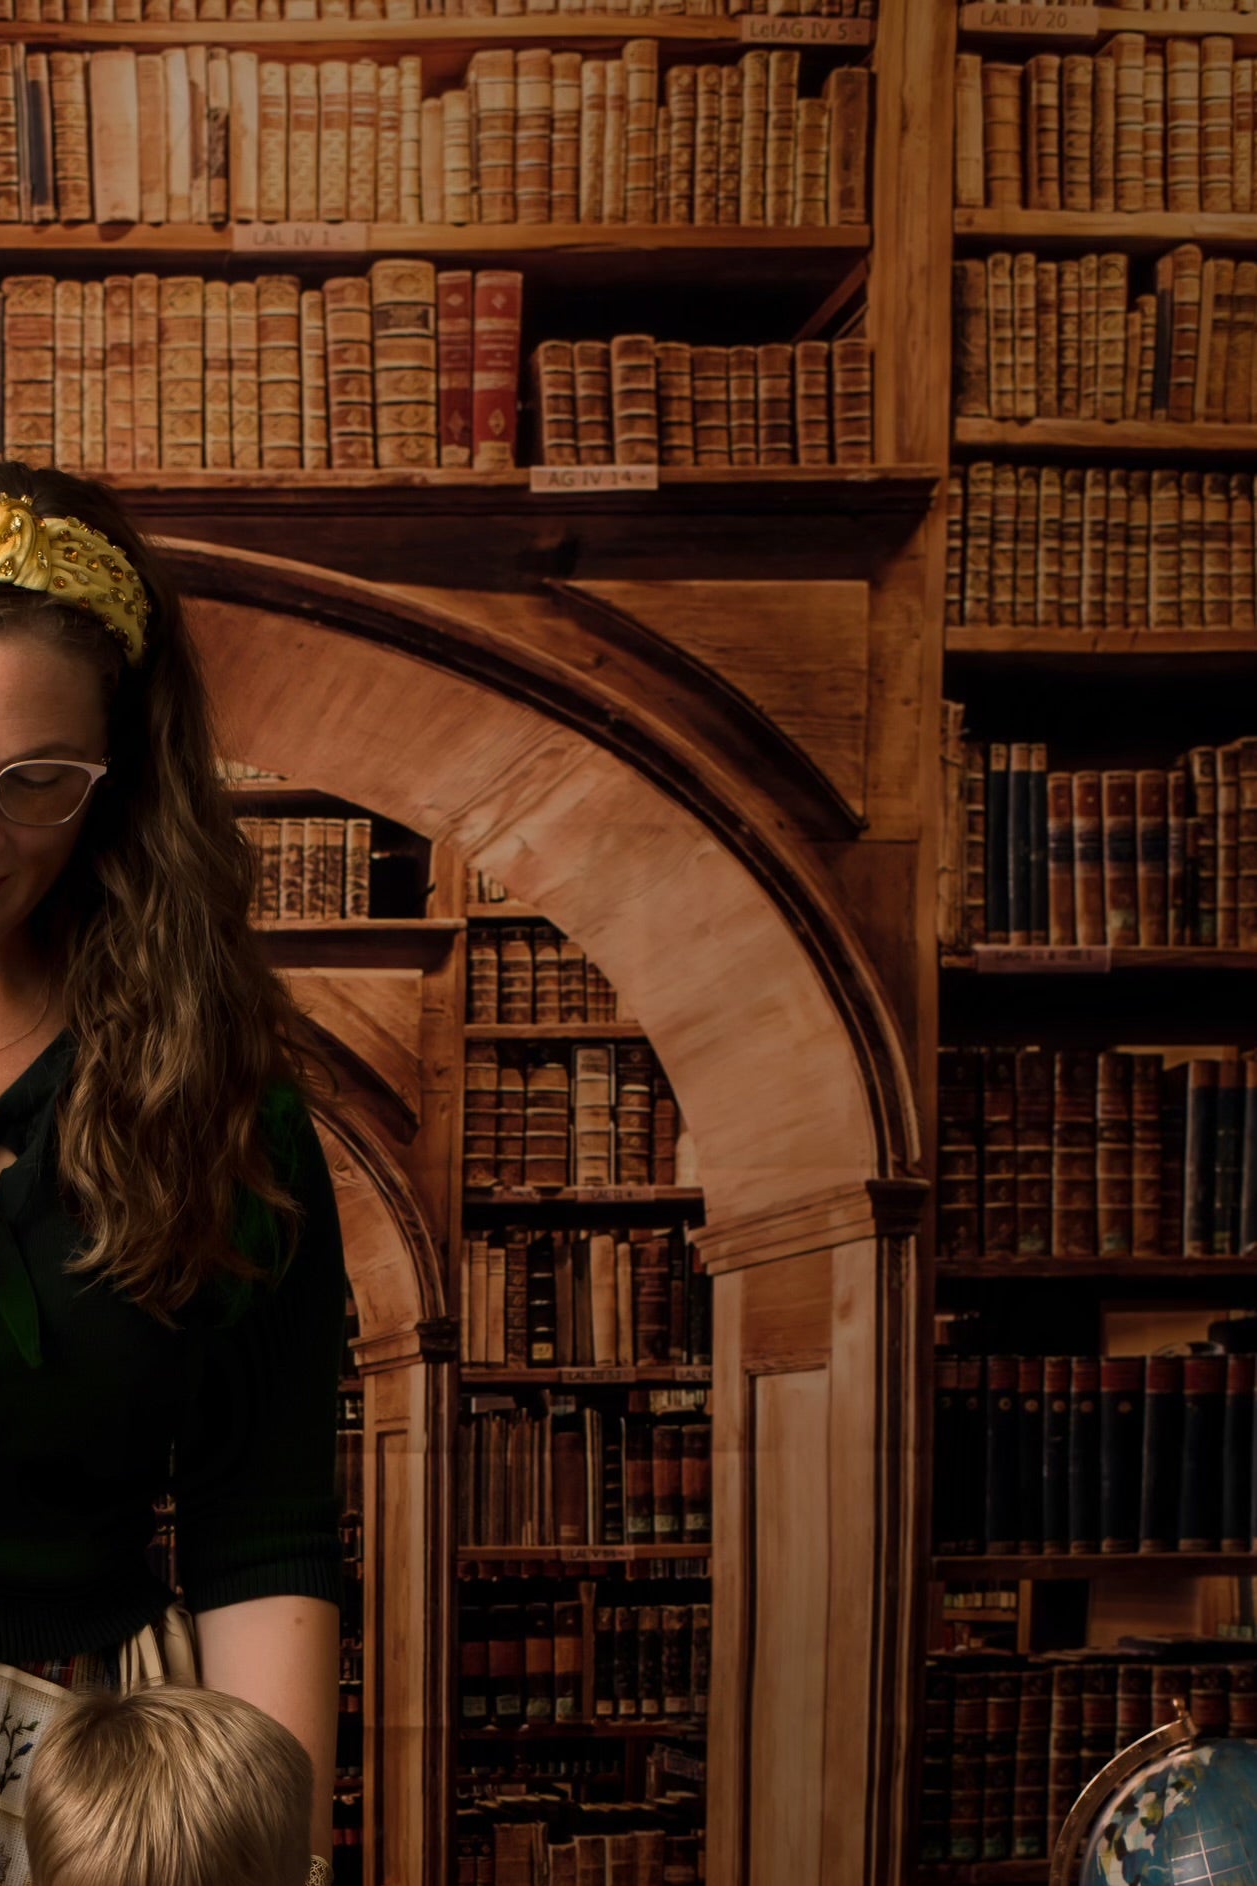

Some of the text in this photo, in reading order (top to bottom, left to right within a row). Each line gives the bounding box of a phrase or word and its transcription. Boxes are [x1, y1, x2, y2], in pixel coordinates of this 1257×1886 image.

[980, 9, 1013, 27] LAL
[1020, 9, 1039, 27] IV
[1045, 11, 1068, 29] 20
[810, 22, 831, 39] IV
[548, 470, 576, 487] AG
[582, 470, 602, 486] IV
